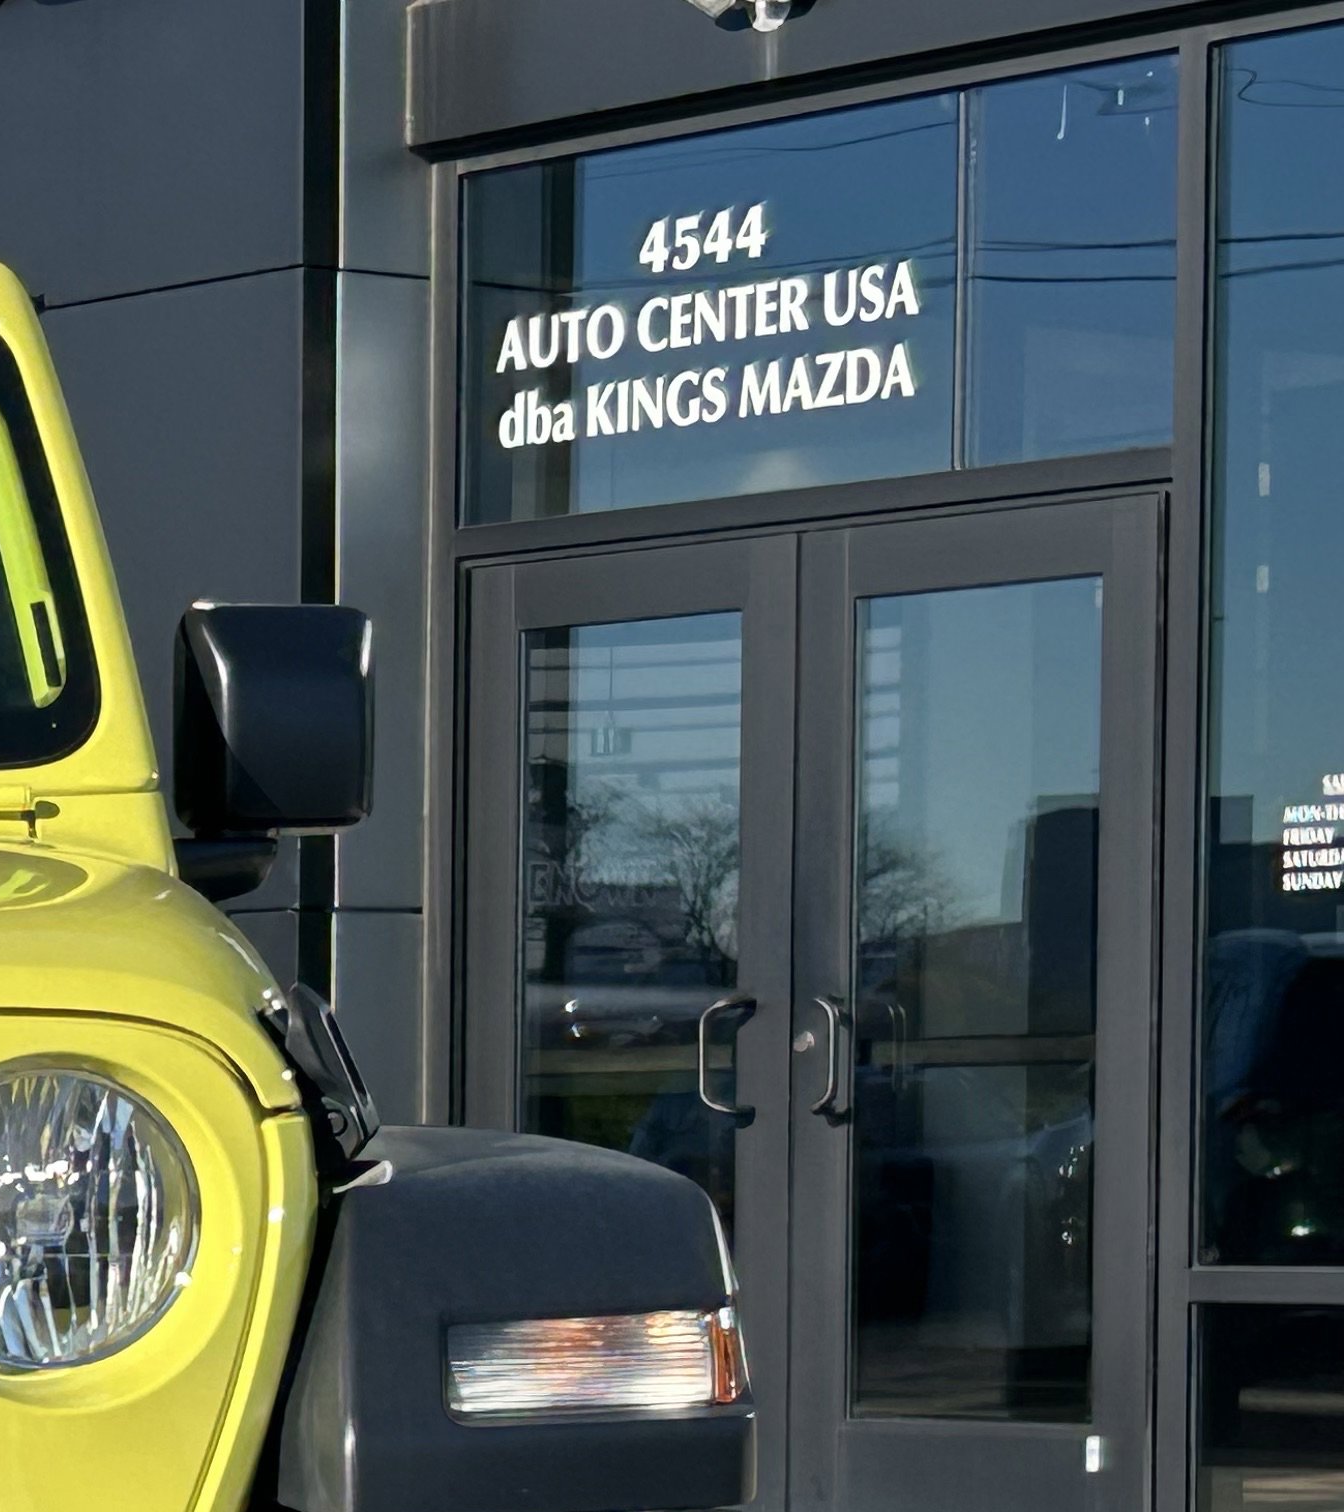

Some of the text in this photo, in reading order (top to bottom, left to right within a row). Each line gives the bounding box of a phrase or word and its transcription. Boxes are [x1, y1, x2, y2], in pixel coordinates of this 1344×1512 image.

[638, 203, 768, 273] 4544
[495, 260, 920, 374] AUTO CENTER USA
[498, 343, 916, 449] dba KINGS MAZDA
[1282, 871, 1343, 891] SUNDAY
